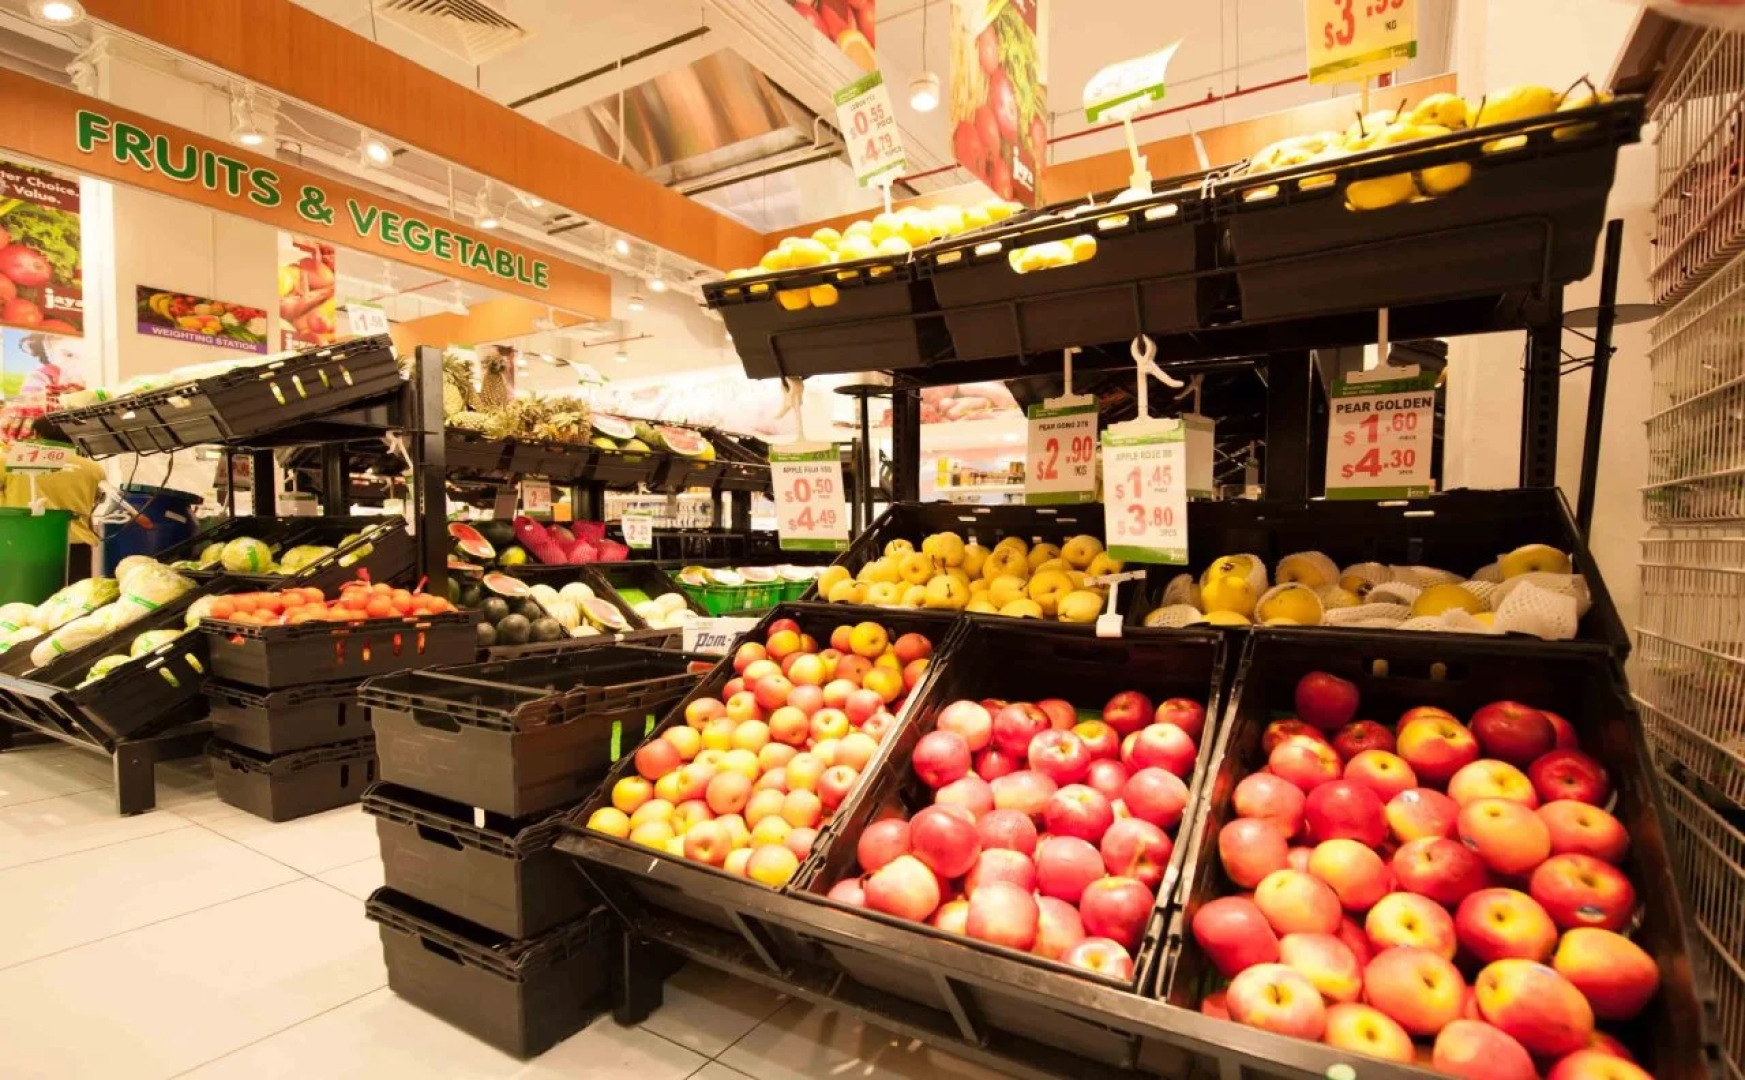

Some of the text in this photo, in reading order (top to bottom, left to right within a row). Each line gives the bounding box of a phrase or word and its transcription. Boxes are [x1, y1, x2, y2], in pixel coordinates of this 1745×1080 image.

[12, 184, 62, 204] Value.
[26, 176, 80, 198] Choice.
[75, 109, 549, 289] FRUITS & VEGETABLE
[152, 326, 257, 351] WEIGHTING STATION
[1336, 397, 1432, 413] PEAR GOLDEN
[1038, 423, 1056, 432] PEAR
